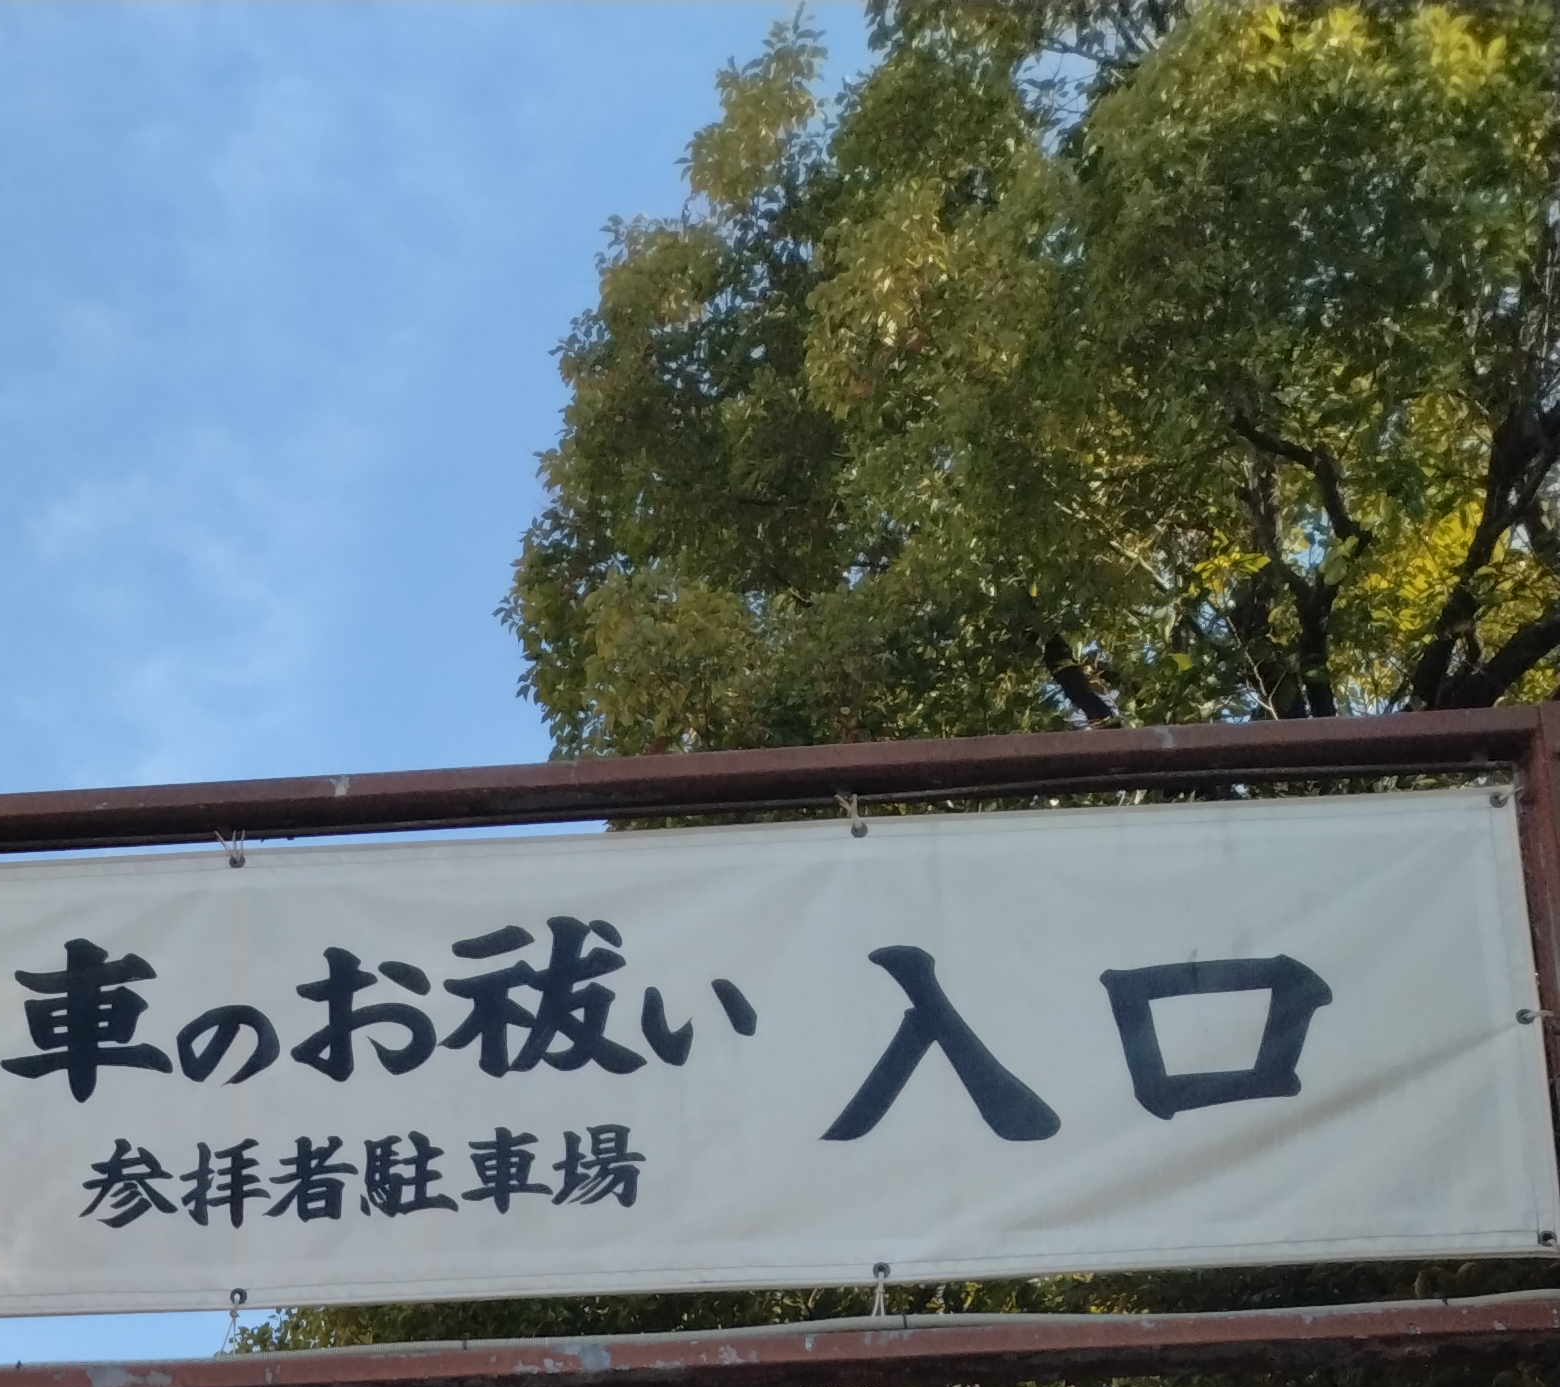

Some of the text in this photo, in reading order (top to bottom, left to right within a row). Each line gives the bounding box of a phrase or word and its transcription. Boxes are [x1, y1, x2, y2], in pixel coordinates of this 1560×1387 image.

[0, 915, 1333, 1142] 車のお祓い 入口
[78, 1123, 647, 1230] 参拝者駐車場
